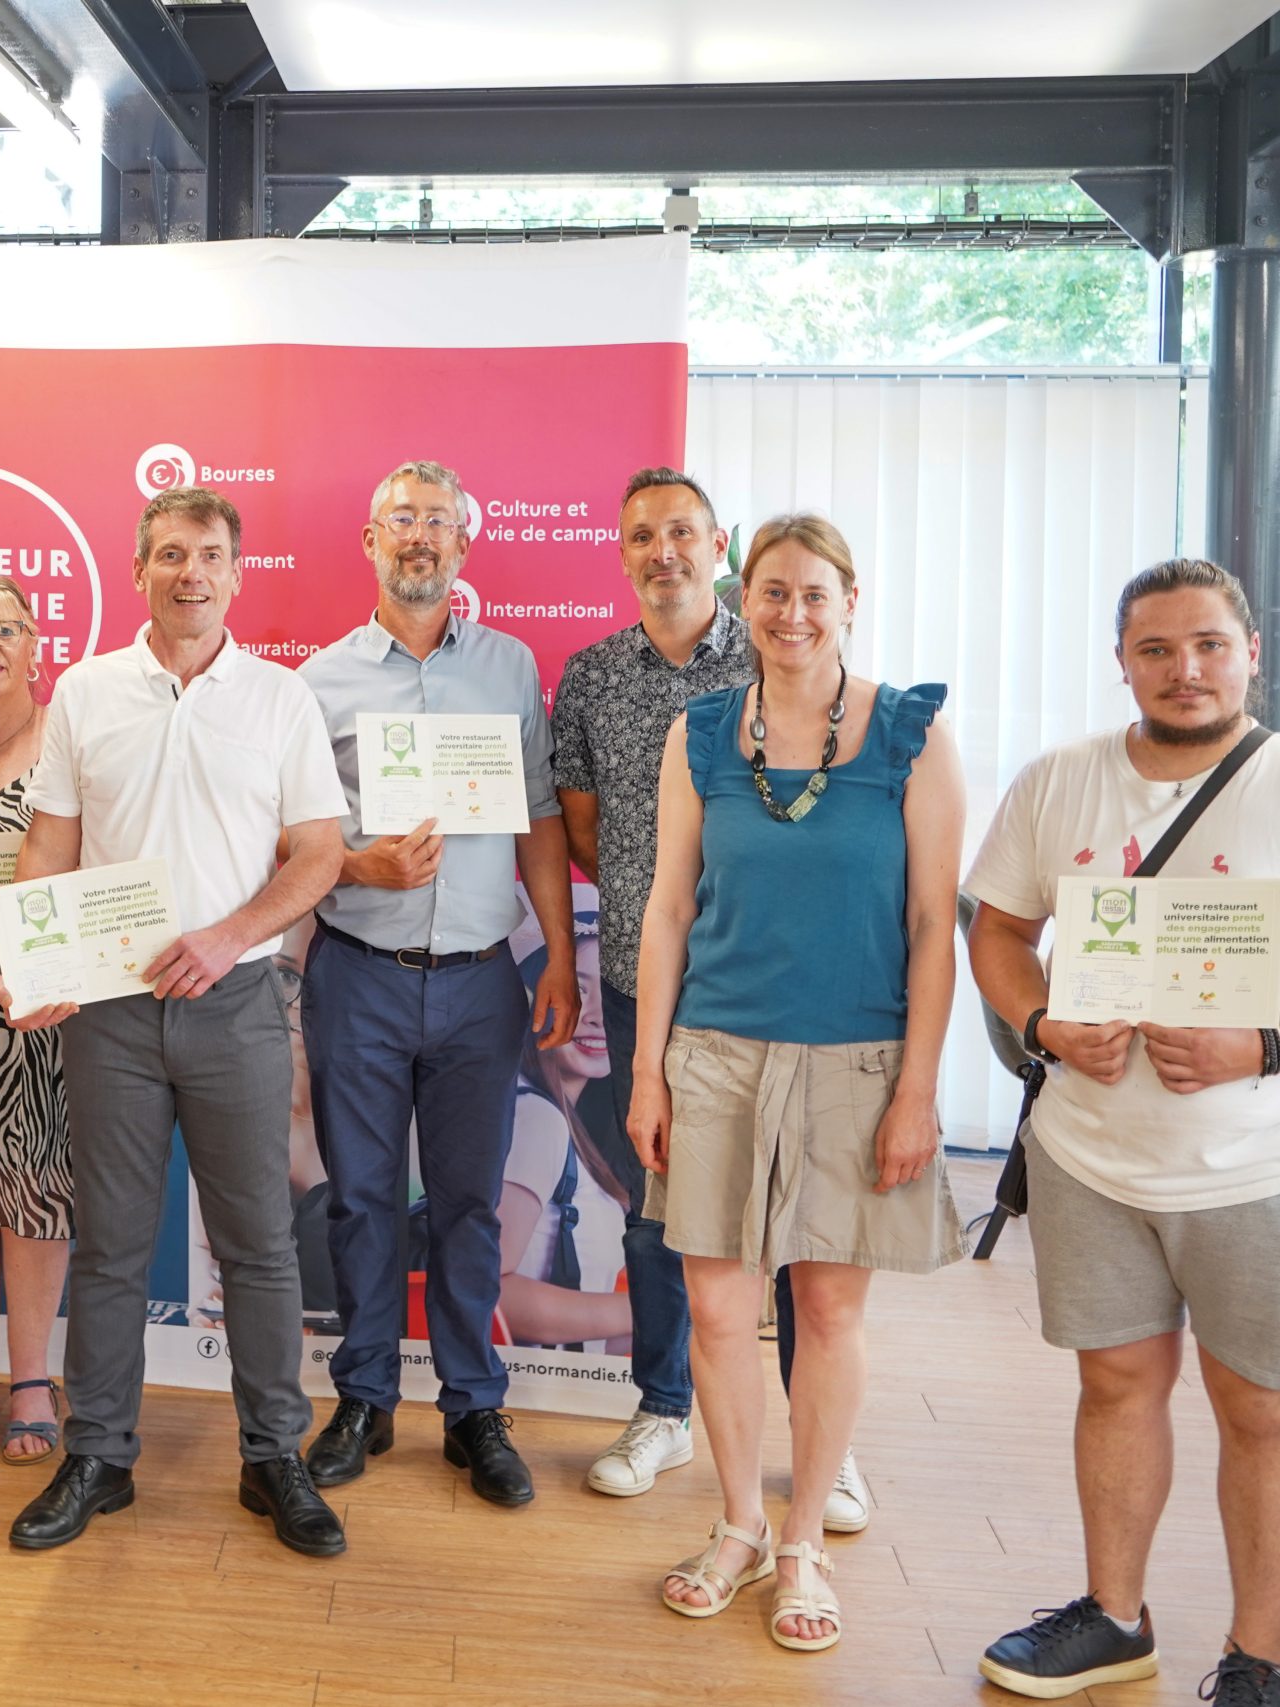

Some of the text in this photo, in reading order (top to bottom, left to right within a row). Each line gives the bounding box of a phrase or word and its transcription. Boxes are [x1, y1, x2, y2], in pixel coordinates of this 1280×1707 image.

[201, 466, 275, 482] Bourses
[486, 500, 588, 517] Culture et
[486, 524, 620, 546] vie de campu
[241, 554, 295, 569] ment
[31, 593, 65, 620] IE
[486, 601, 614, 618] International
[235, 640, 320, 657] auration
[83, 880, 151, 898] Votre restaurant
[79, 894, 131, 909] universitaire
[1172, 903, 1258, 911] Votre restaurant
[115, 907, 167, 922] alimentation
[1164, 913, 1230, 922] universitaire
[99, 925, 121, 935] saine
[1204, 935, 1269, 944] alimentation
[1181, 946, 1208, 954] saine
